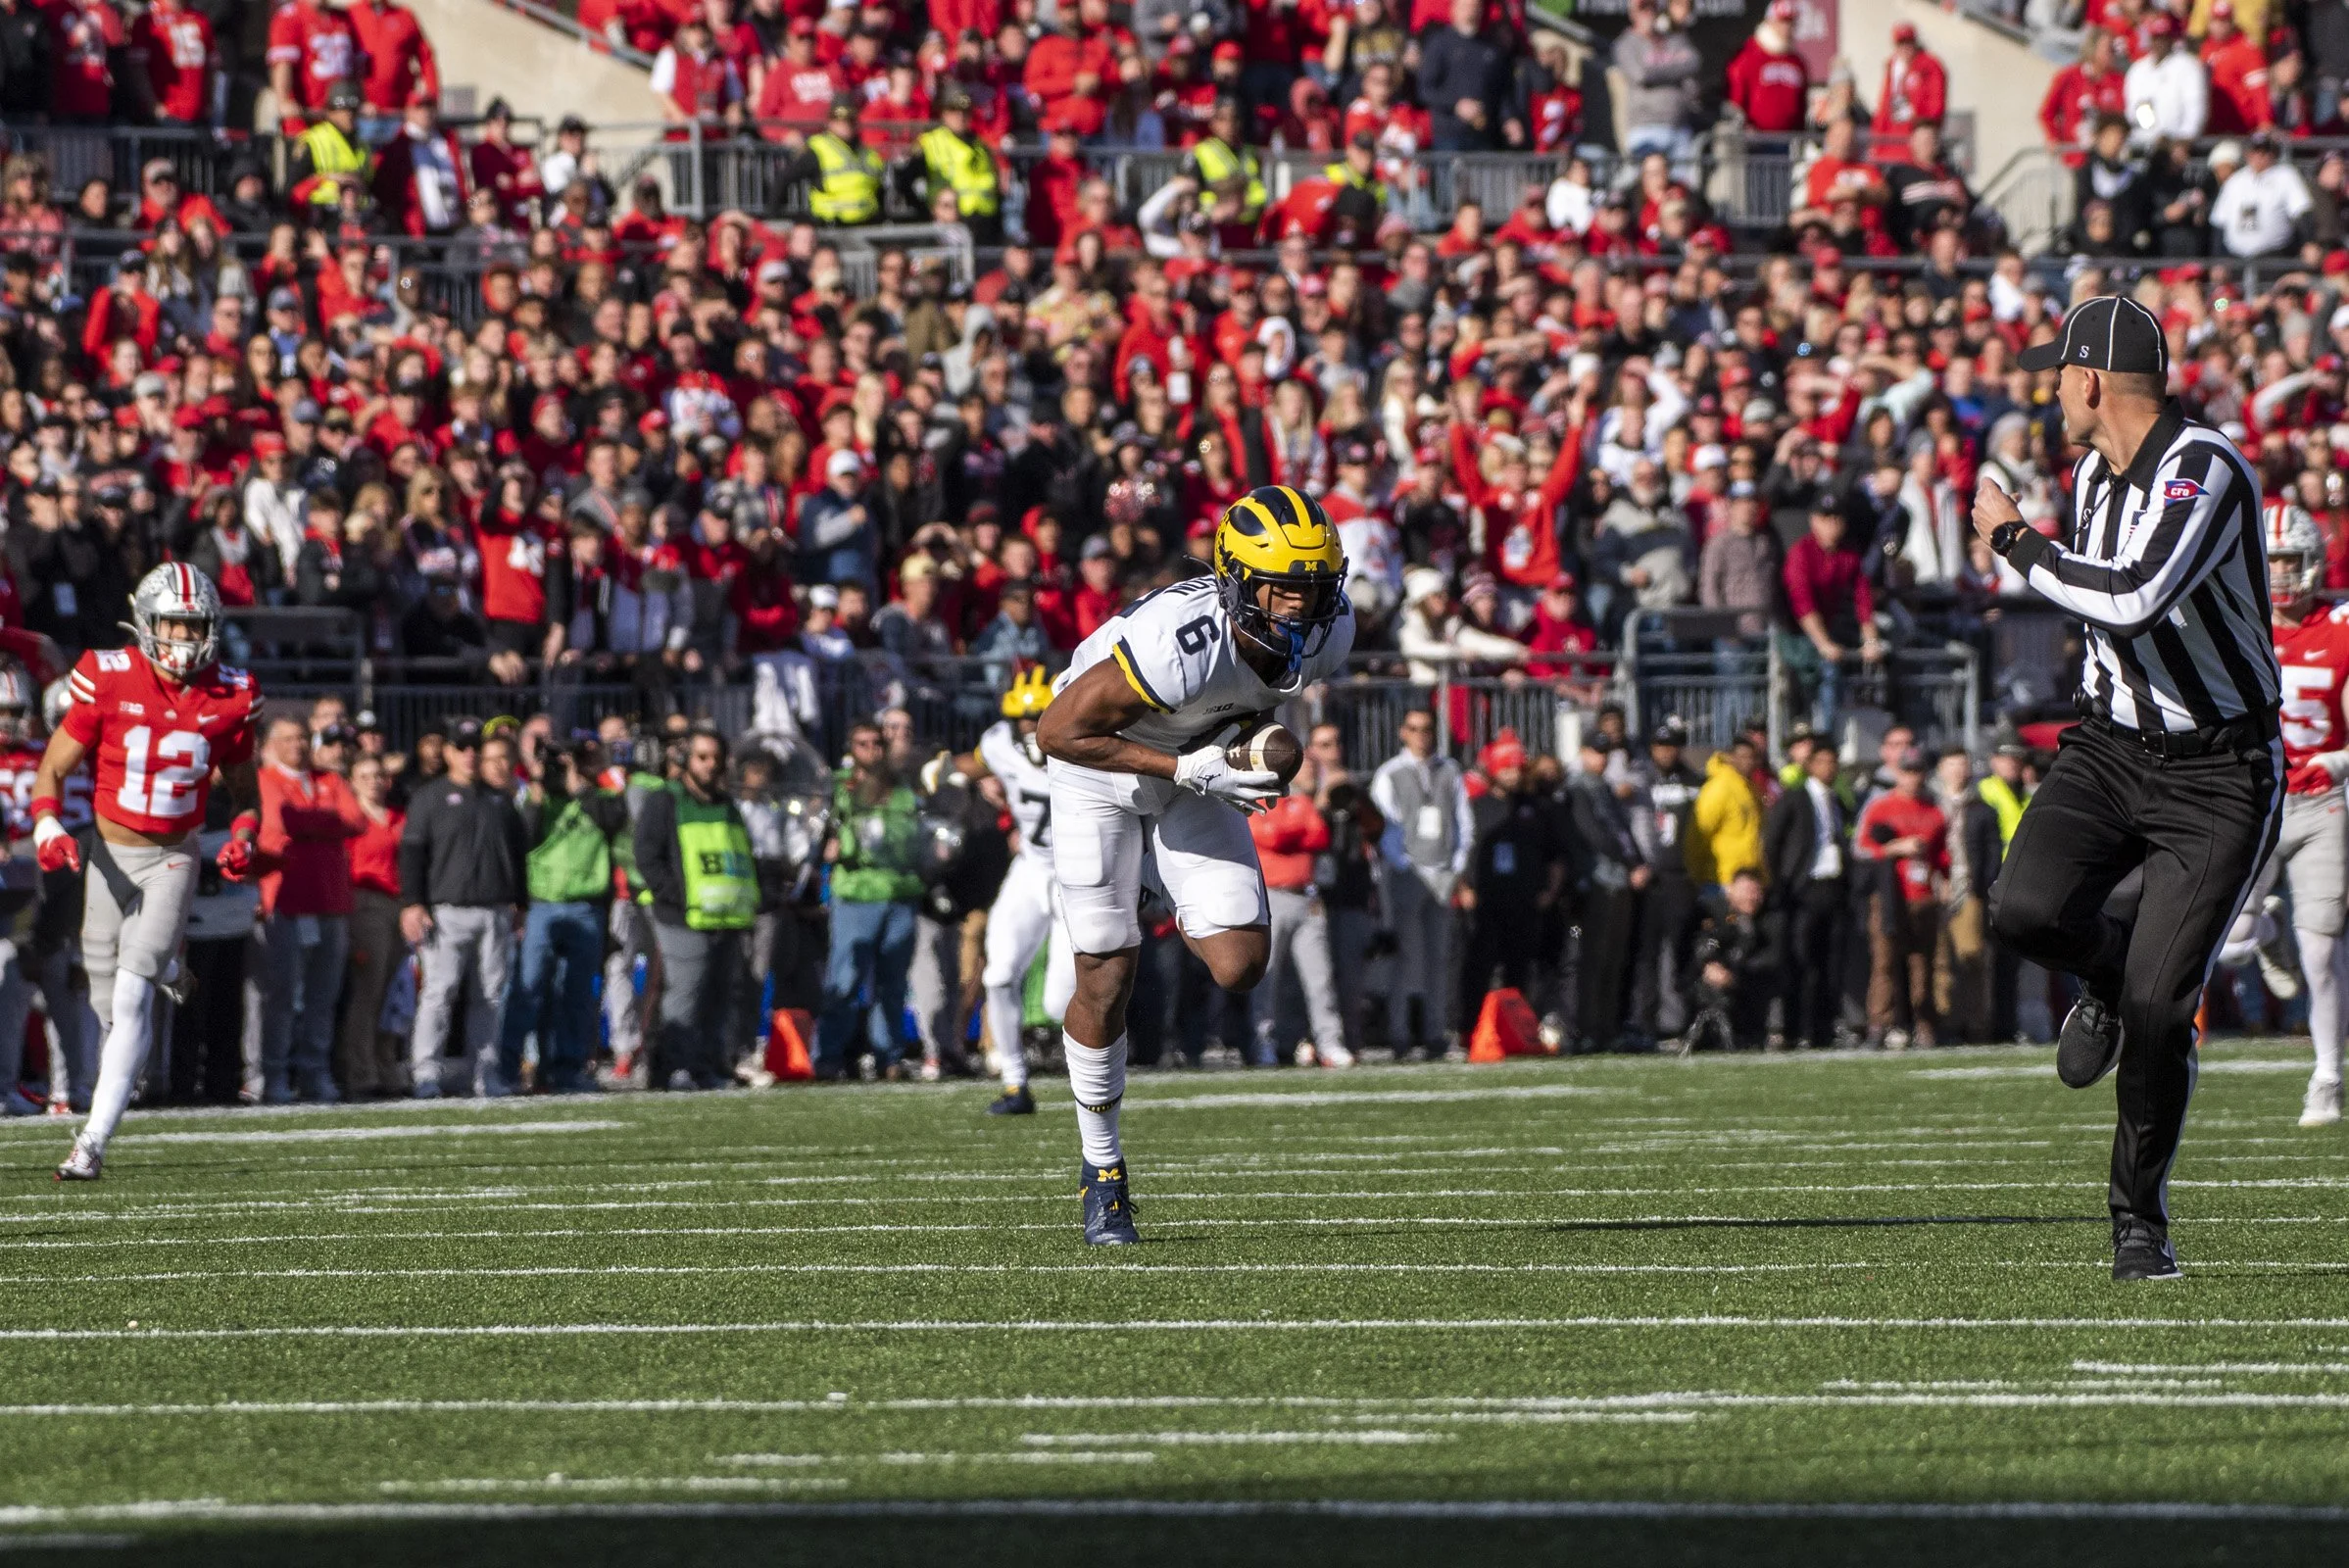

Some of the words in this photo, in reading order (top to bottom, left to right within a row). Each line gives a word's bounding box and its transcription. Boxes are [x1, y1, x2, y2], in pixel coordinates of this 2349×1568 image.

[2079, 345, 2089, 359] S
[2170, 487, 2190, 497] CFO
[1304, 561, 1318, 571] M
[1175, 614, 1221, 656] 6
[118, 724, 212, 818] 12
[1019, 789, 1052, 848] 7
[1098, 1167, 1122, 1183] M
